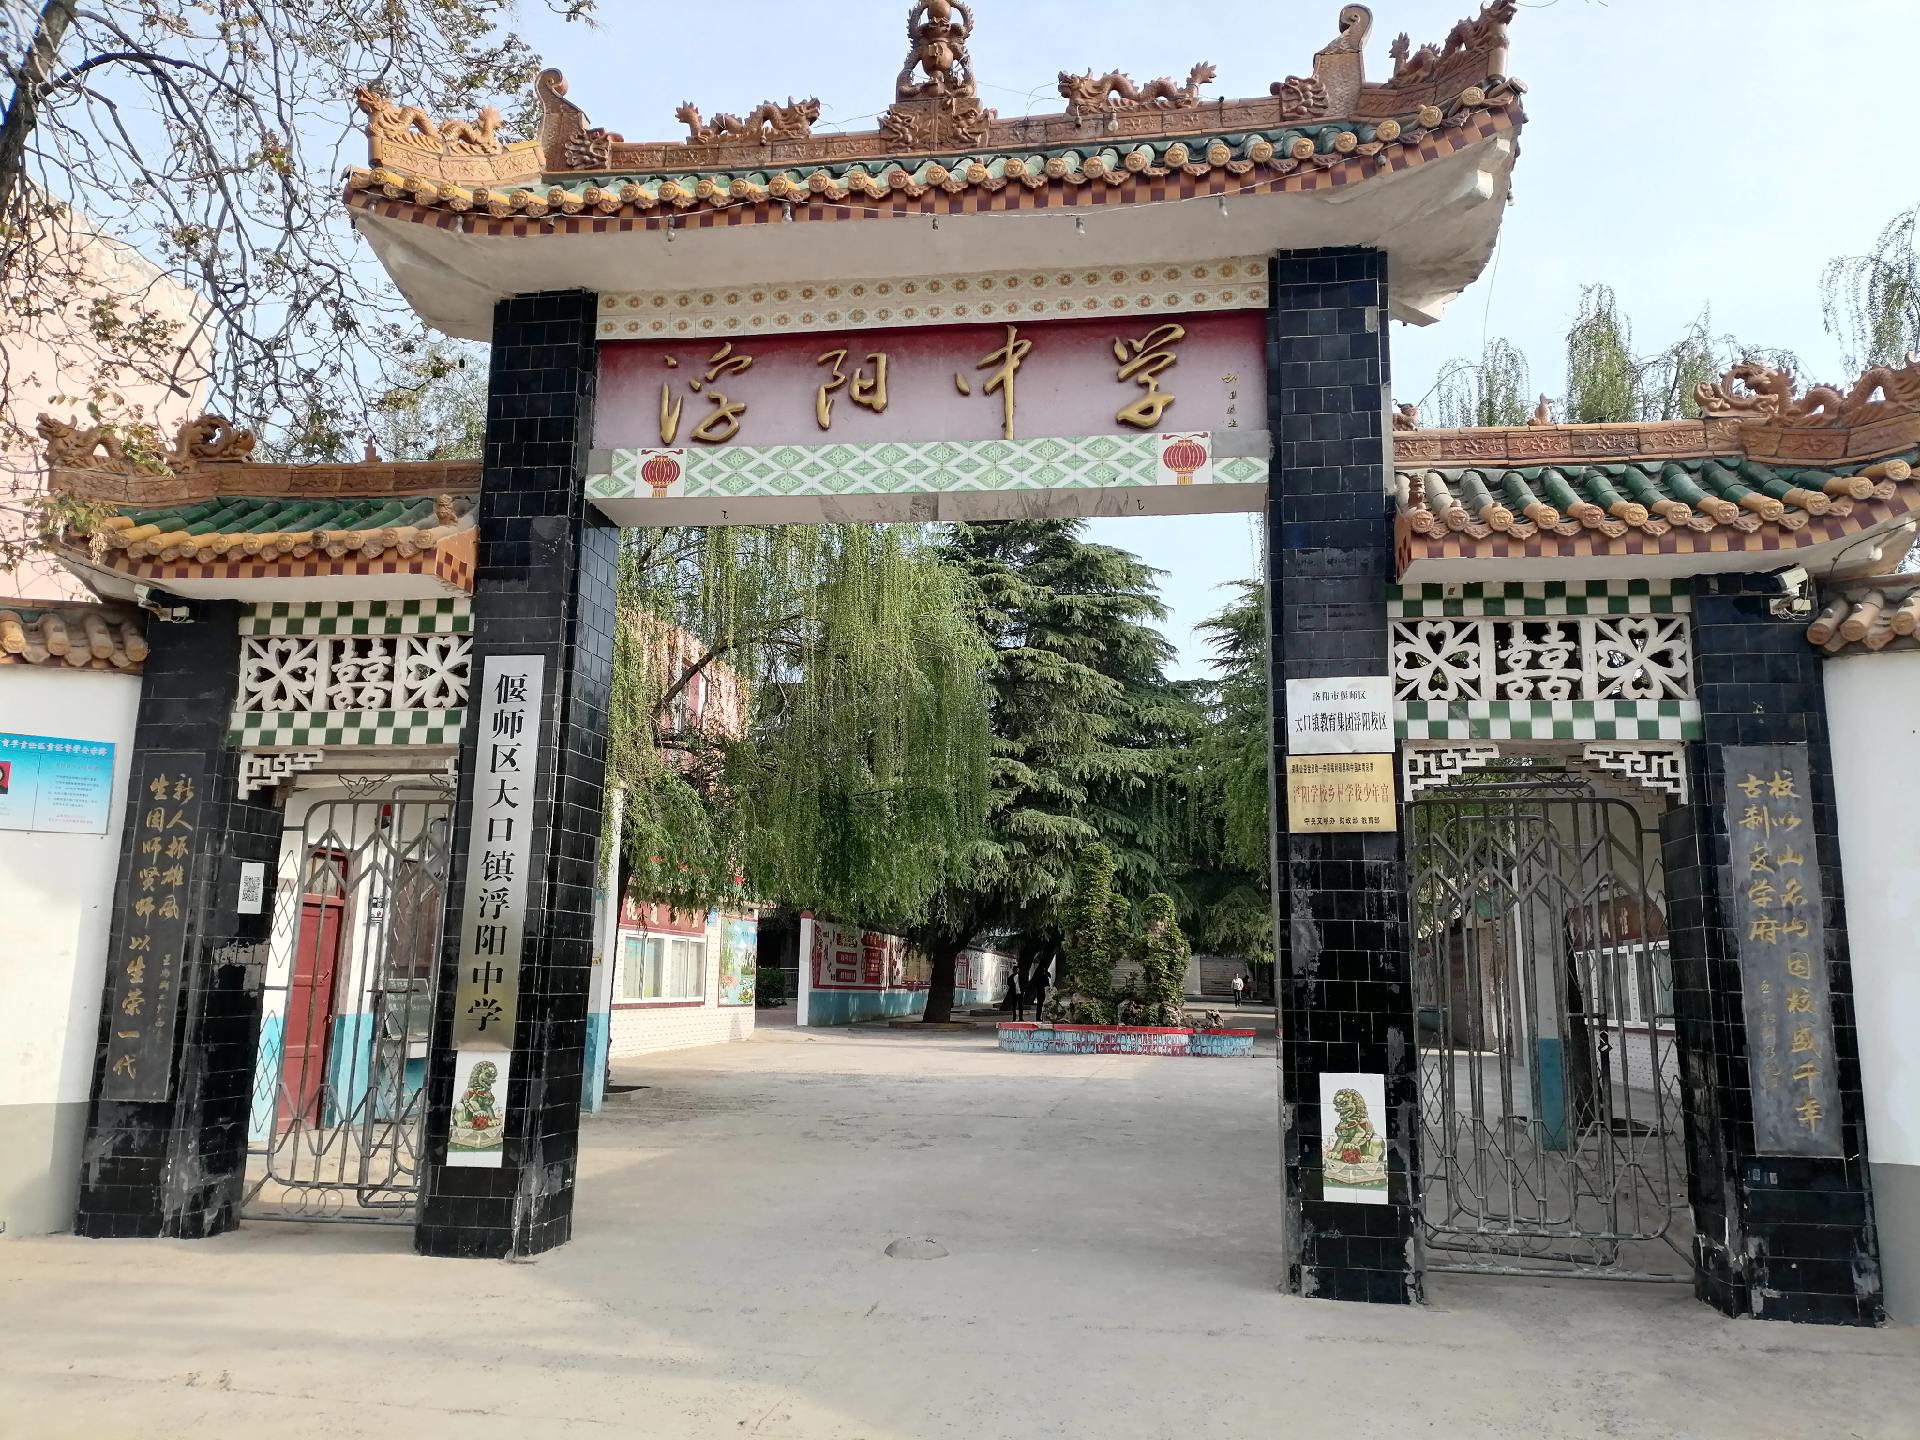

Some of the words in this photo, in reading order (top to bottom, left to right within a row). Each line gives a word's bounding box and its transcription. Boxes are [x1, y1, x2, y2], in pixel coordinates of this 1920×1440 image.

[1312, 690, 1367, 702] 洛阳市偃师区
[1294, 711, 1388, 733] 大口镇教育集团浮阳校区
[466, 673, 529, 1032] 偃师区大口镇浮阳中学
